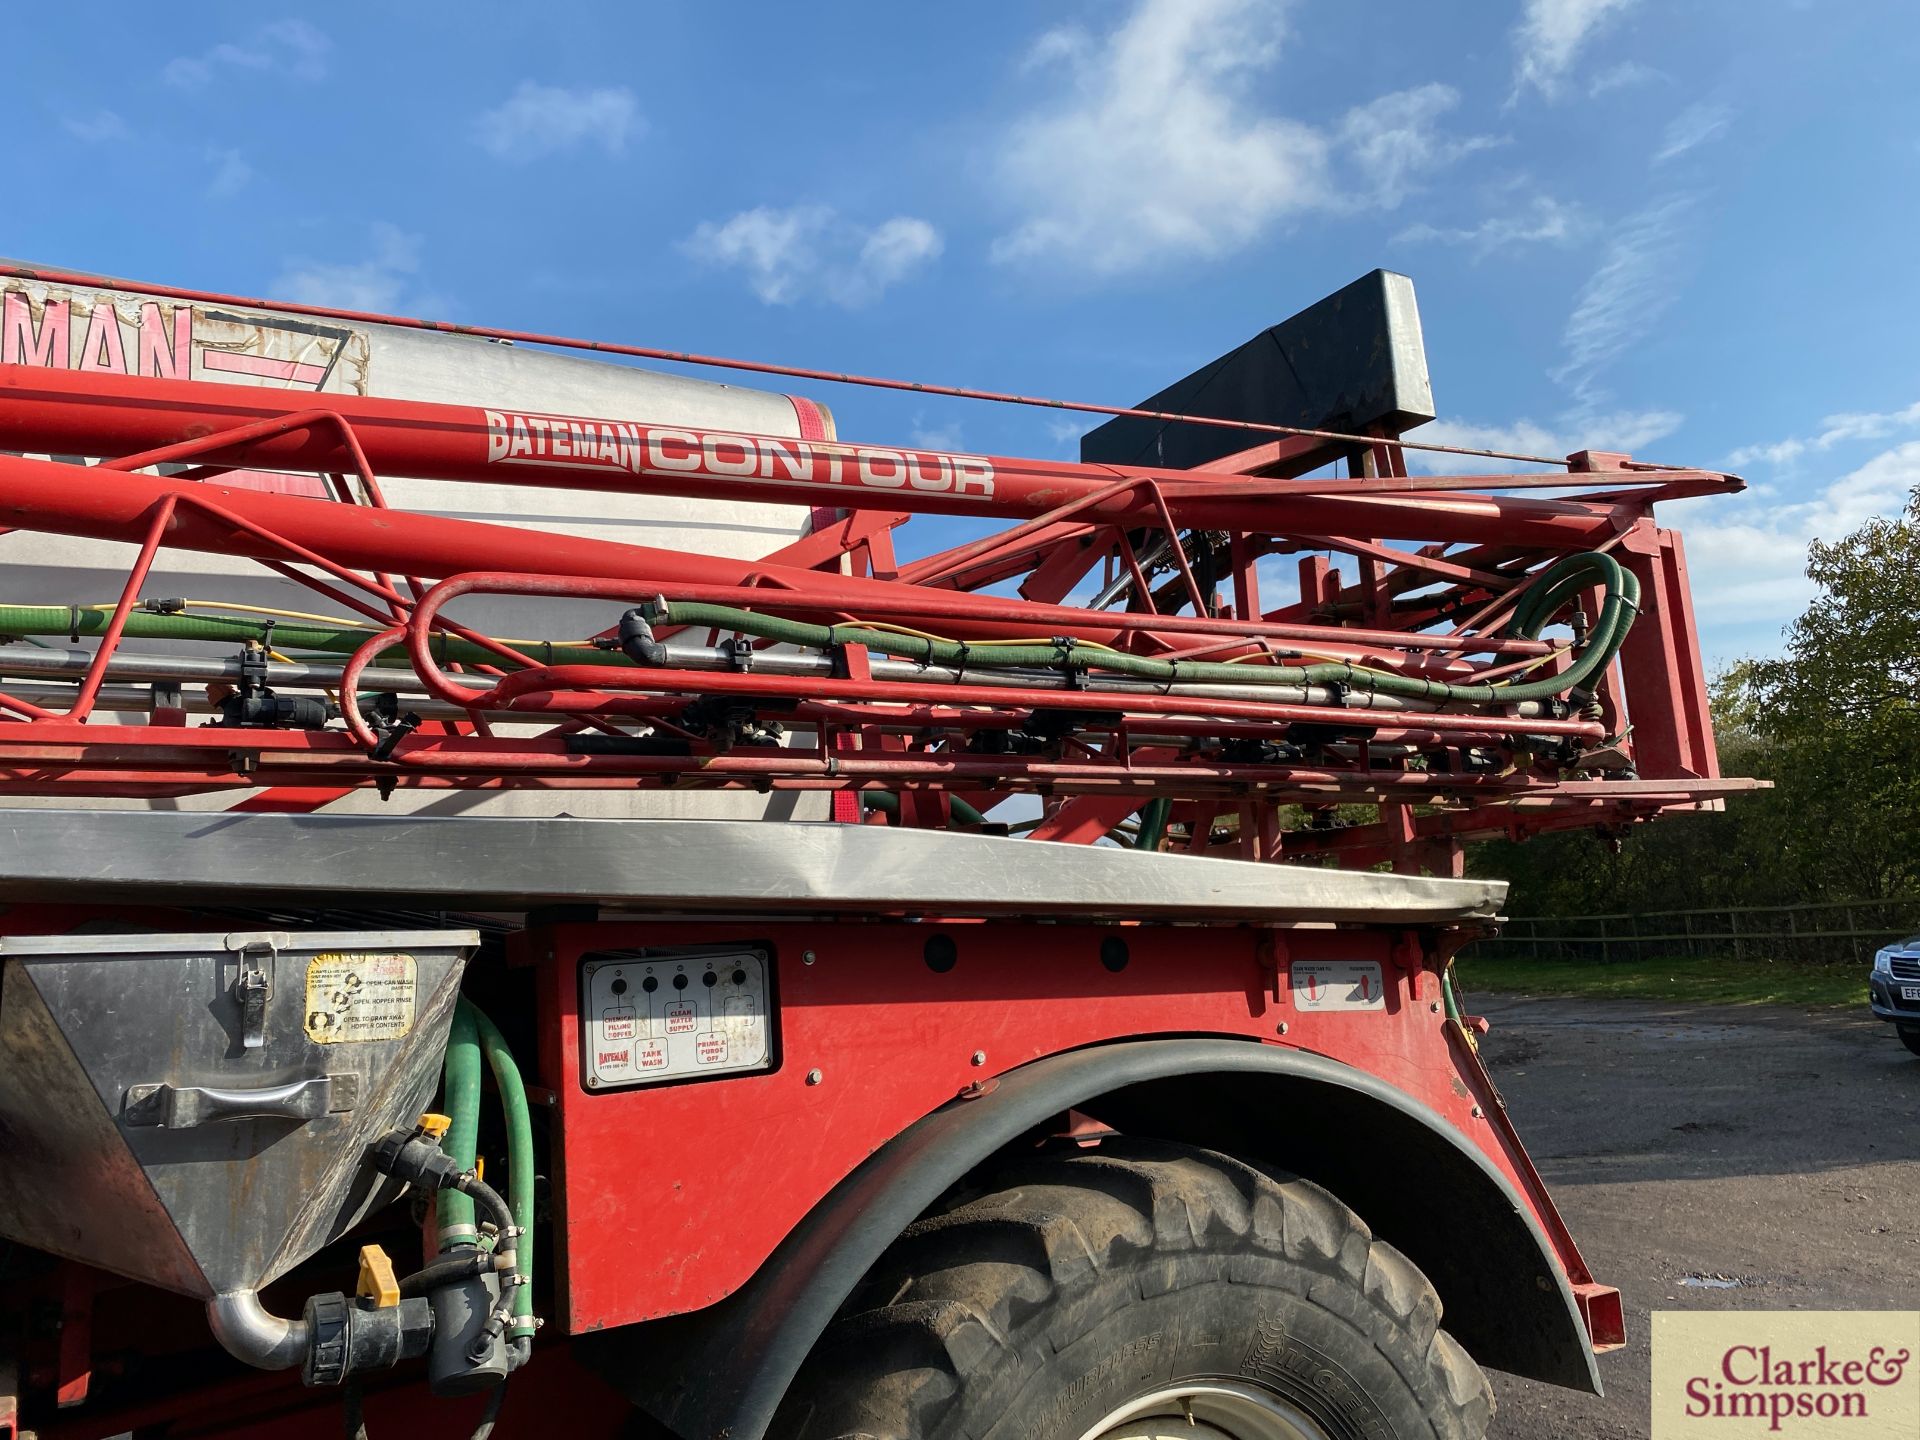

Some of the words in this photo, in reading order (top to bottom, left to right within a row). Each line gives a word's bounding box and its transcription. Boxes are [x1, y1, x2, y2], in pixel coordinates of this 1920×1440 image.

[484, 408, 641, 475] BATEMAN
[646, 428, 996, 496] CONTOUR
[670, 1009, 692, 1017] CLEAN
[669, 1017, 693, 1025] WATER
[668, 1024, 694, 1033] SUPPLY
[649, 1041, 654, 1049] 2
[697, 1040, 719, 1048] PRIME
[641, 1049, 662, 1058] TANK
[700, 1047, 724, 1056] PURGE
[598, 1049, 629, 1066] BATEMAN
[641, 1058, 663, 1067] WASH
